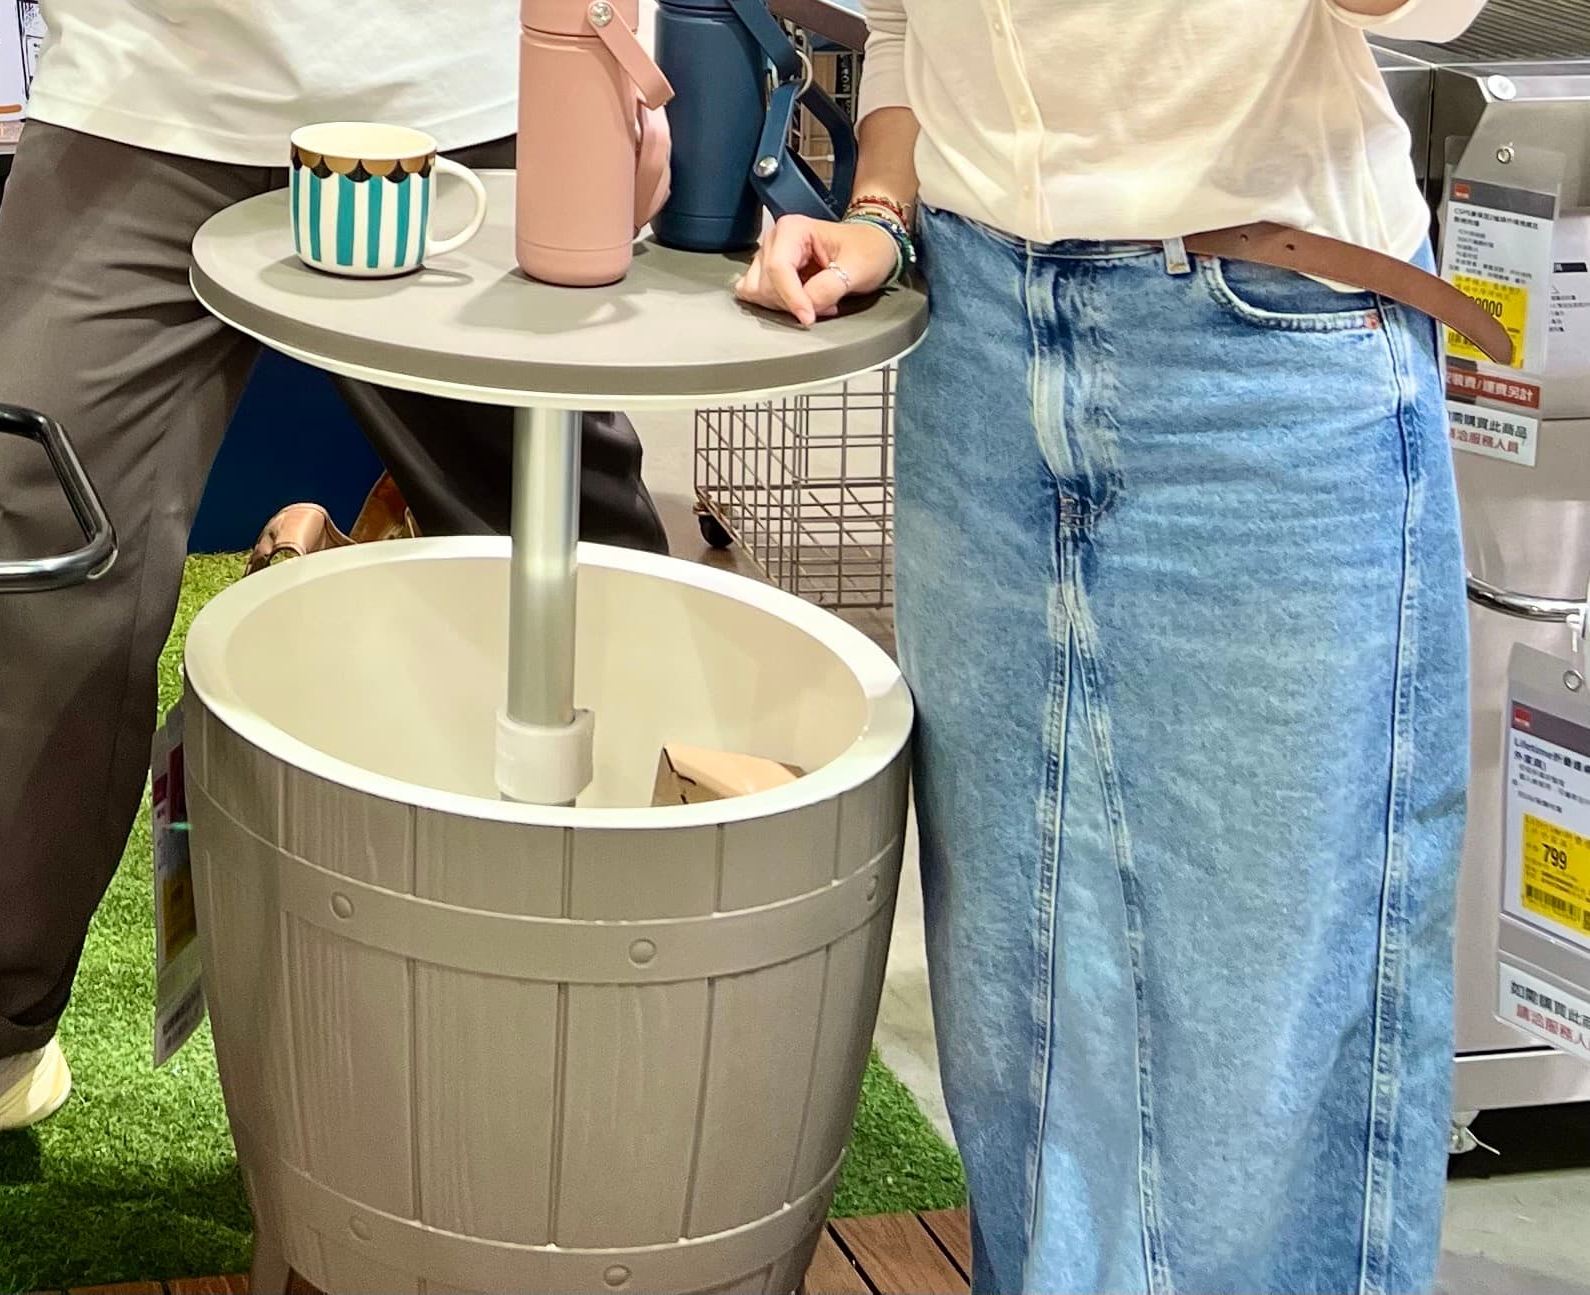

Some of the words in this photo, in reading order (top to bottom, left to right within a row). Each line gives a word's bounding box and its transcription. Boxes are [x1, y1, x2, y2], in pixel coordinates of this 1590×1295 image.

[1448, 410, 1528, 439] 需購買此商品
[1542, 843, 1568, 871] 799
